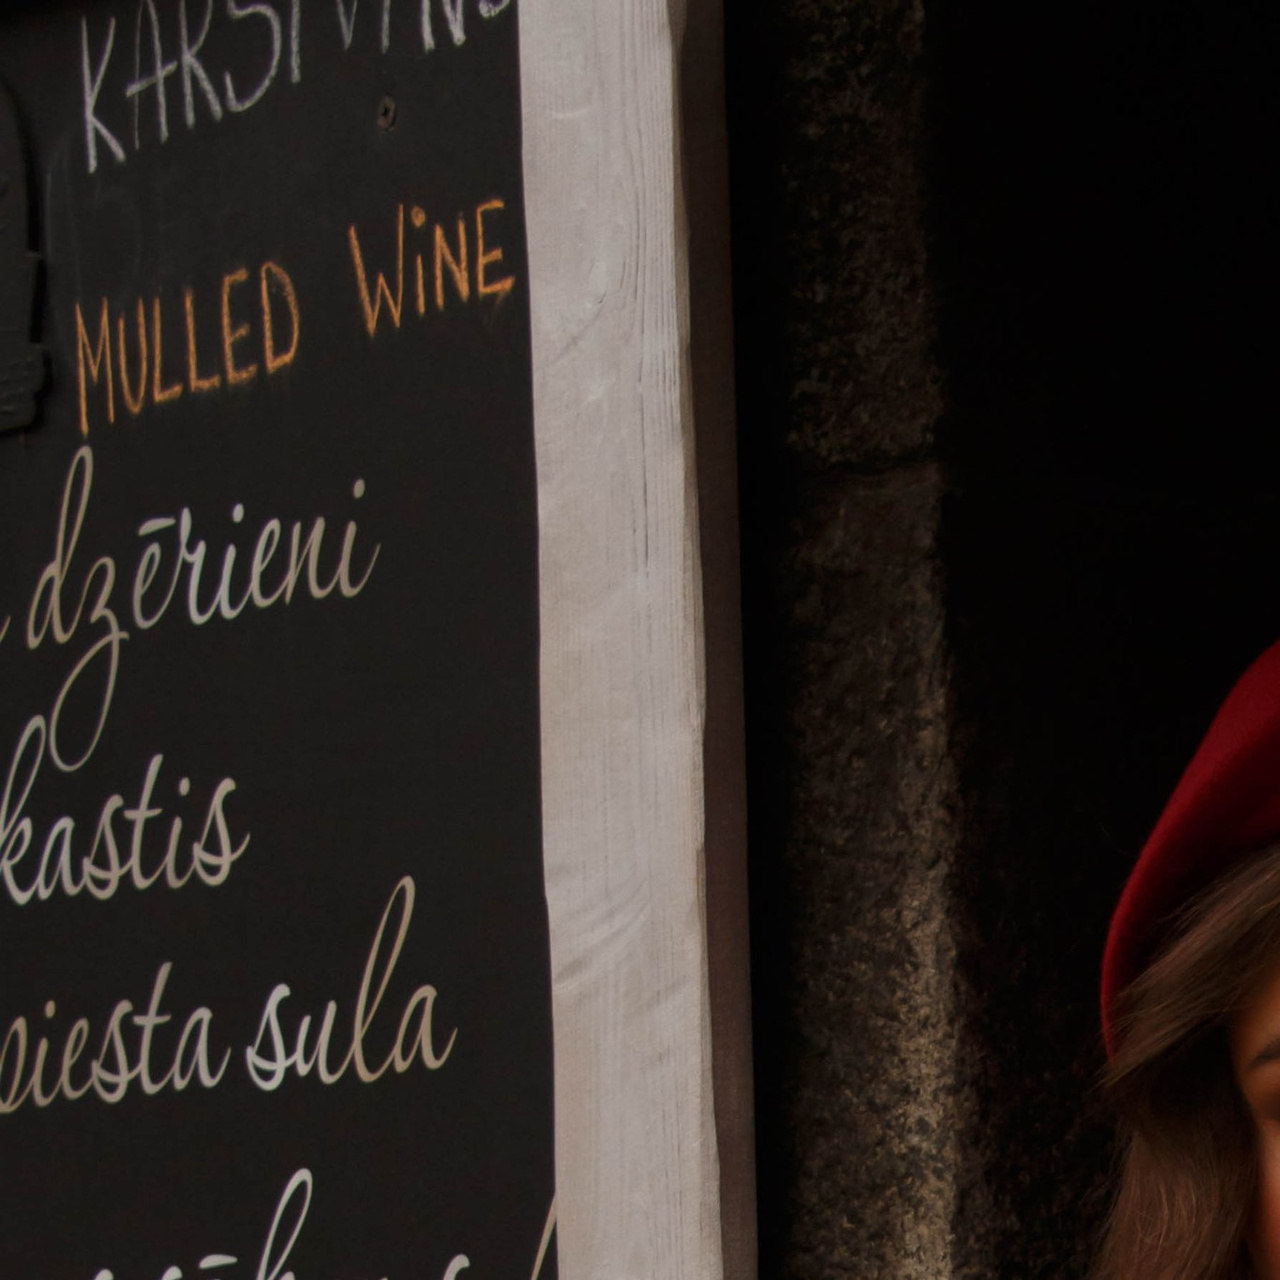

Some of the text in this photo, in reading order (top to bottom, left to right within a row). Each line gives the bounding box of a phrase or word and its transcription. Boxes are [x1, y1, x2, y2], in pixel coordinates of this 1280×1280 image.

[75, 260, 300, 438] MULLED
[26, 445, 380, 772] dzērieni
[245, 875, 458, 1091] sula
